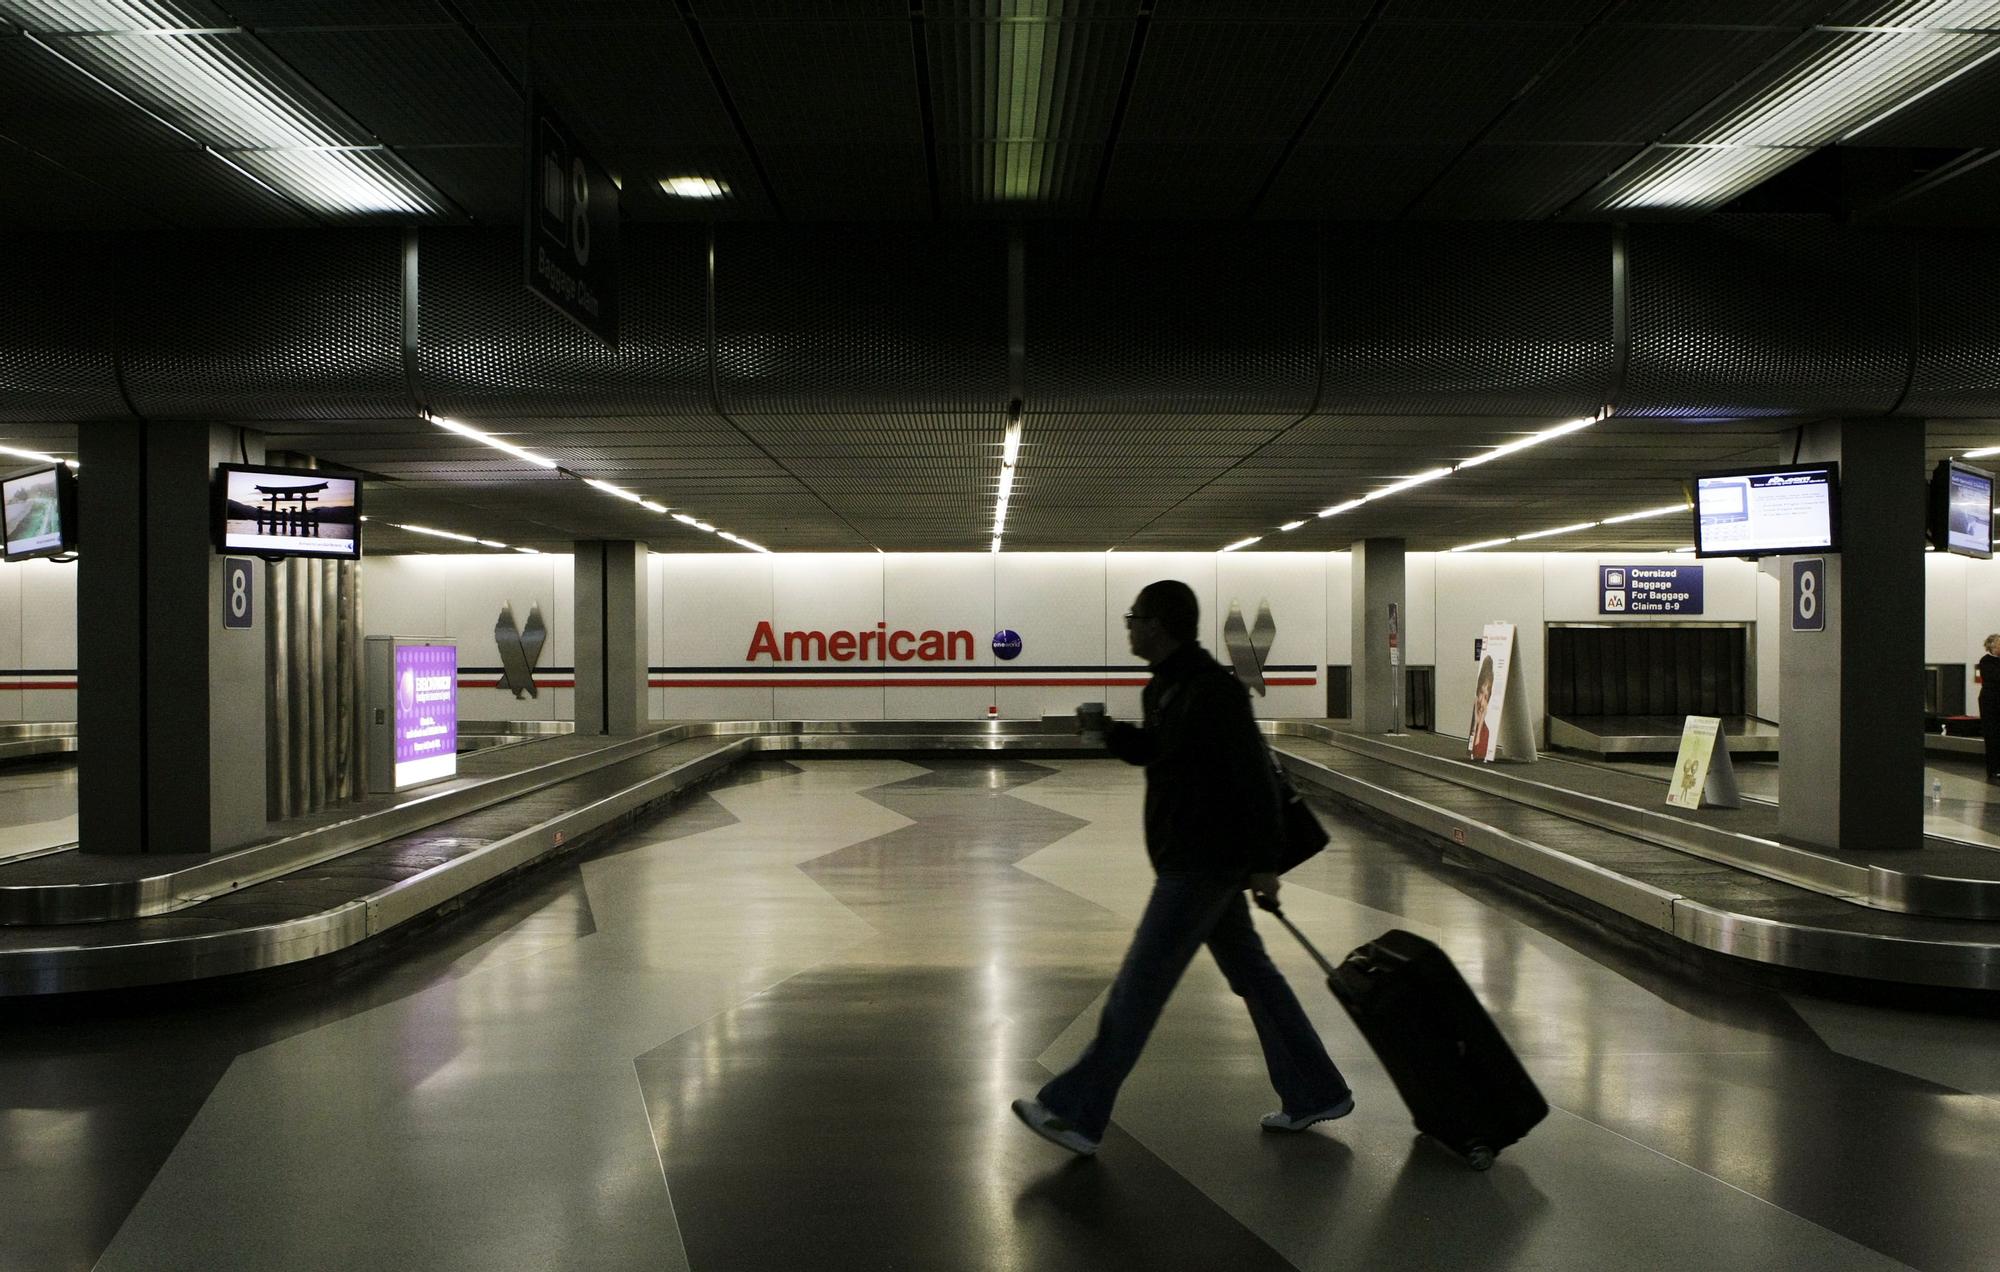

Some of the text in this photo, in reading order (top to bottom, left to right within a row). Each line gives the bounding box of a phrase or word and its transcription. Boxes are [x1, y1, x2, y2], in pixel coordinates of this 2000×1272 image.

[572, 157, 590, 267] 8
[539, 246, 576, 301] Baggage
[1632, 569, 1677, 578] Oversized
[1632, 580, 1672, 590] Baggage
[232, 569, 246, 618] 8
[1632, 591, 1689, 601] For Baggage
[1800, 570, 1816, 619] 8
[1632, 602, 1680, 611] Claims 8-9
[745, 621, 974, 661] American
[993, 639, 1020, 648] oneworld
